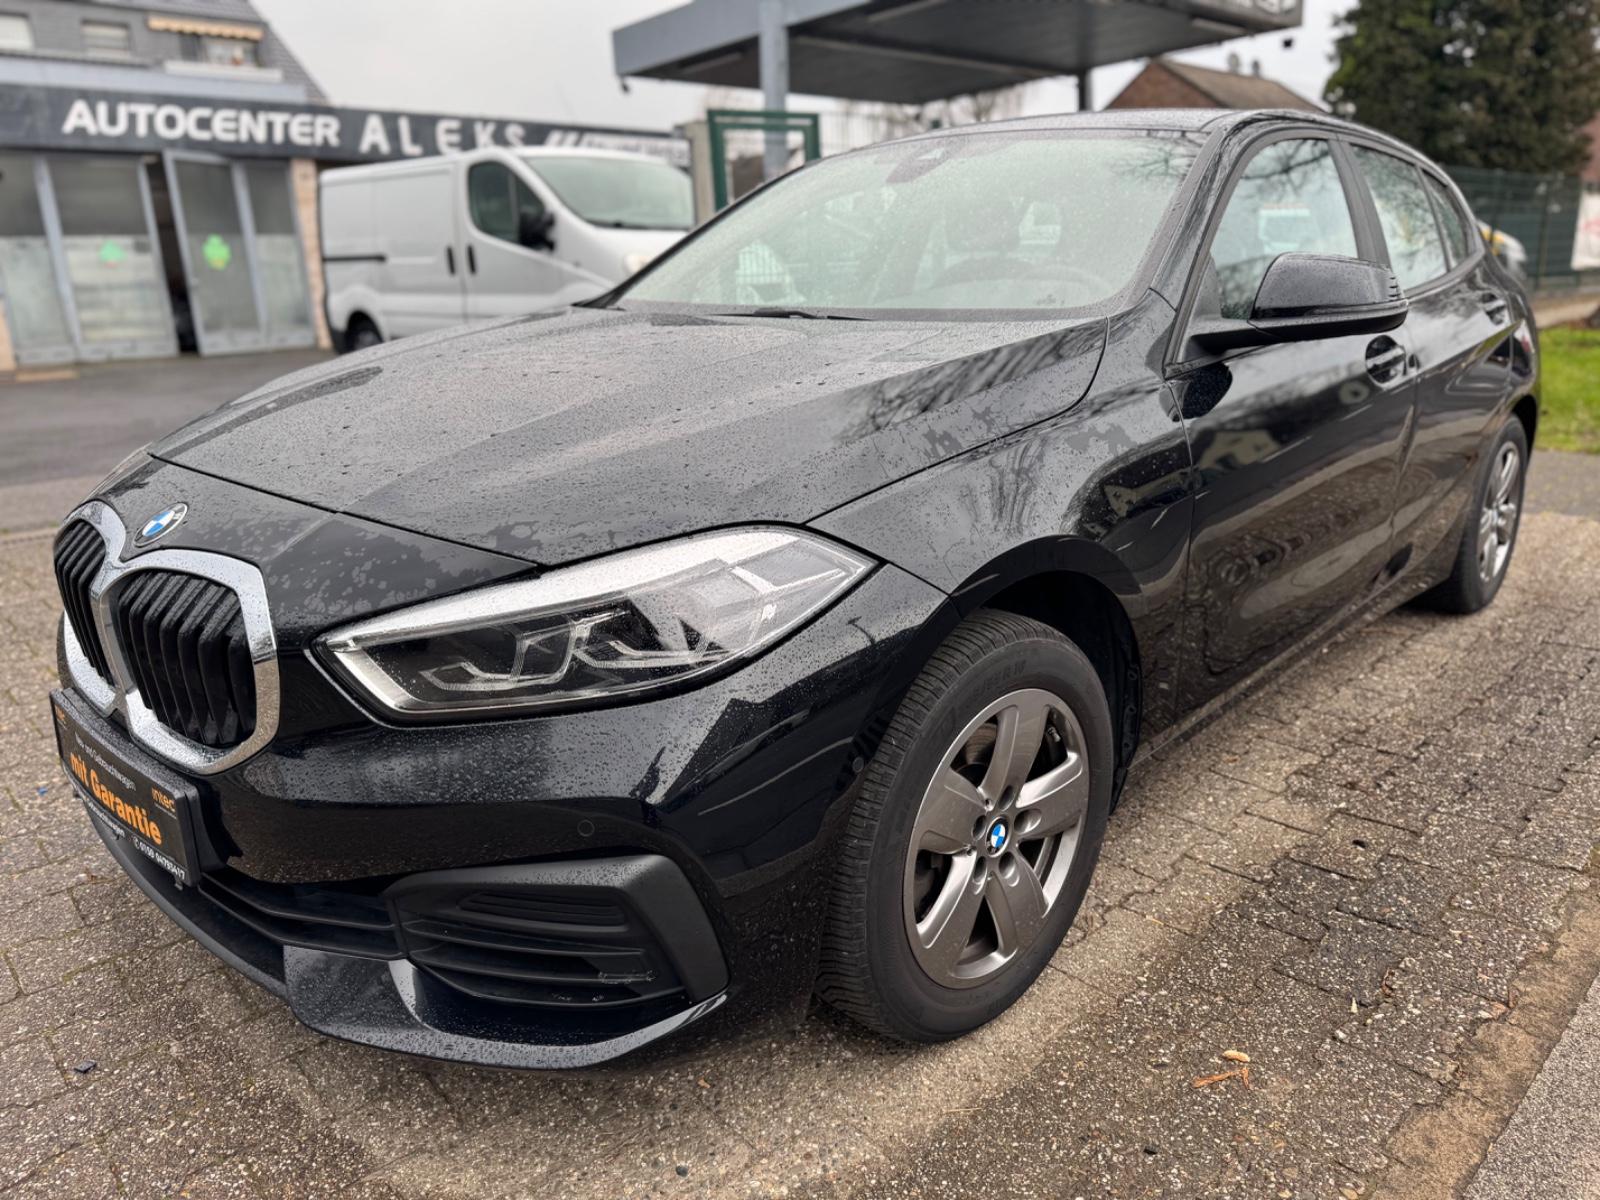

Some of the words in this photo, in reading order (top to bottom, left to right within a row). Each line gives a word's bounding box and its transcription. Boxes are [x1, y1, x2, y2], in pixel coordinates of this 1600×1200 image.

[62, 99, 341, 147] AUTOCENTER
[360, 113, 526, 155] ALEKS
[90, 769, 162, 846] Garantie
